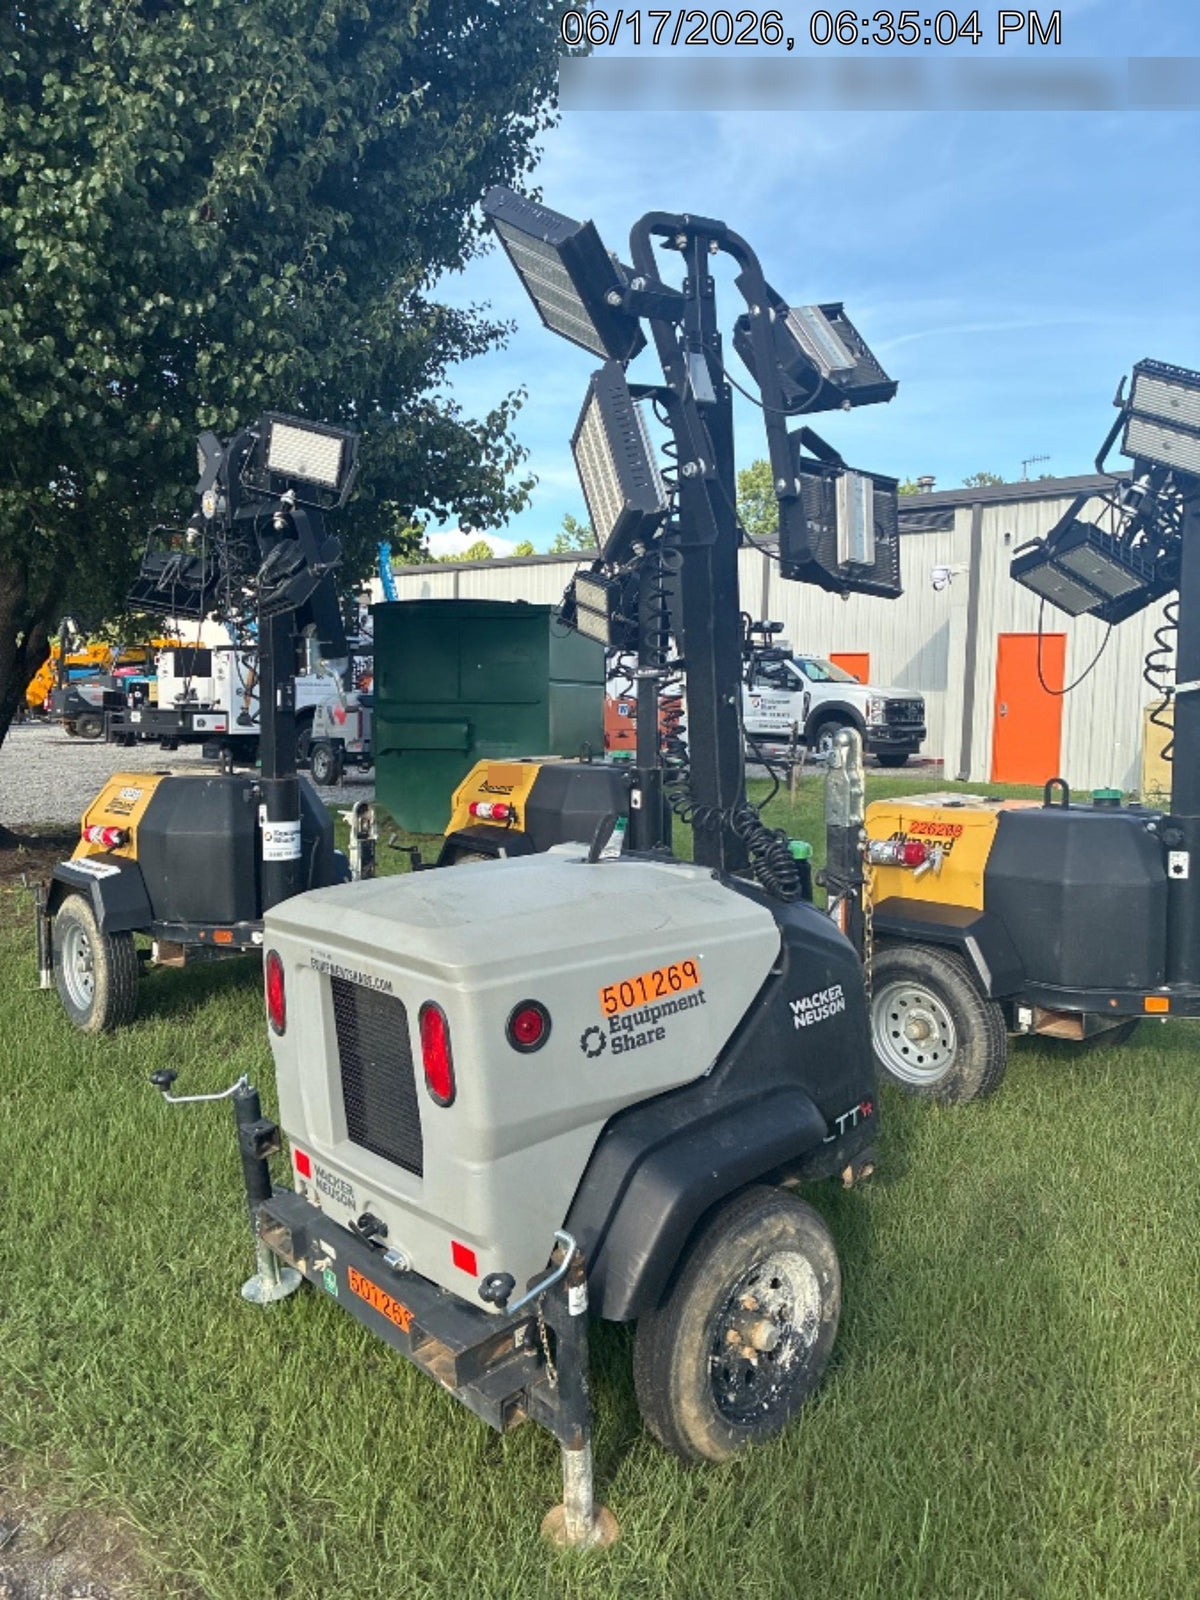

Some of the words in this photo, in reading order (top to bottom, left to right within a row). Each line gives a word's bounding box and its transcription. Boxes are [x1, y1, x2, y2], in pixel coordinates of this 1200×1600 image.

[602, 961, 698, 1014] 501269
[789, 984, 844, 1014] WACKER
[607, 989, 707, 1035] Equipment
[794, 996, 846, 1030] NEUSON
[610, 1026, 666, 1055] Share
